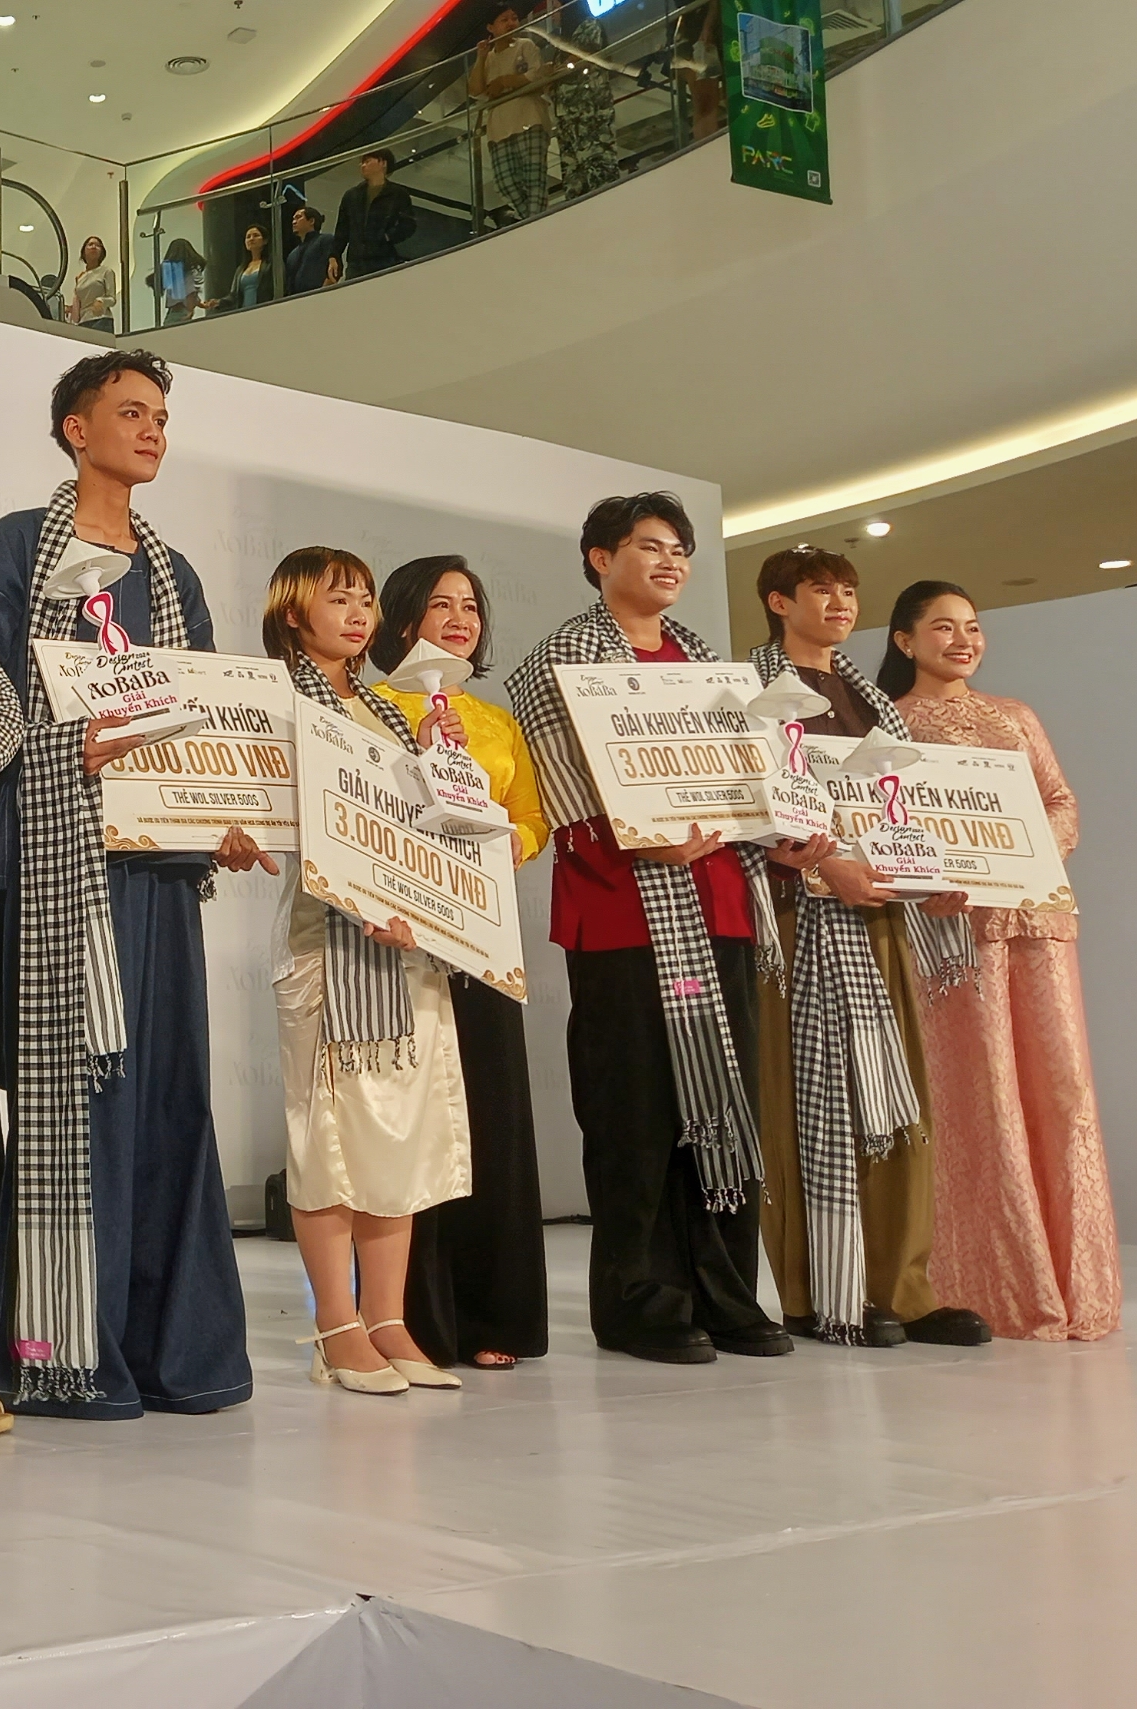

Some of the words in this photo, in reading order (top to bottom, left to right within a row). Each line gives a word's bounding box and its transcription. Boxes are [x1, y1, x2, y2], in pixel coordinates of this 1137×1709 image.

[741, 145, 794, 174] PARC
[96, 652, 135, 669] Design
[113, 657, 154, 676] Contest
[98, 703, 142, 719] Khuyến
[144, 694, 178, 709] Khích
[122, 690, 147, 703] Giải
[215, 703, 274, 735] KHÍCH
[611, 706, 645, 738] GIẢI
[645, 704, 706, 735] KHUYẾN
[702, 706, 750, 734] KHÍCH
[235, 743, 291, 779] VNĐ
[618, 744, 725, 779] 3.000.000
[721, 743, 767, 774] VNĐ
[172, 789, 191, 805] THẺ
[189, 791, 210, 805] WOL
[208, 793, 239, 806] SILVER
[338, 767, 369, 806] GIẢI
[373, 785, 435, 840] KHUYẾ
[826, 774, 865, 803] GIẢI
[868, 780, 943, 809] KYẾN
[944, 786, 1003, 813] KHÍCH
[960, 818, 1015, 850] VNĐ
[334, 801, 444, 887] 3.000.000
[446, 859, 487, 911] VNĐ
[382, 873, 397, 892] THẺ
[397, 880, 413, 899] WOL
[413, 890, 437, 913] SILVER
